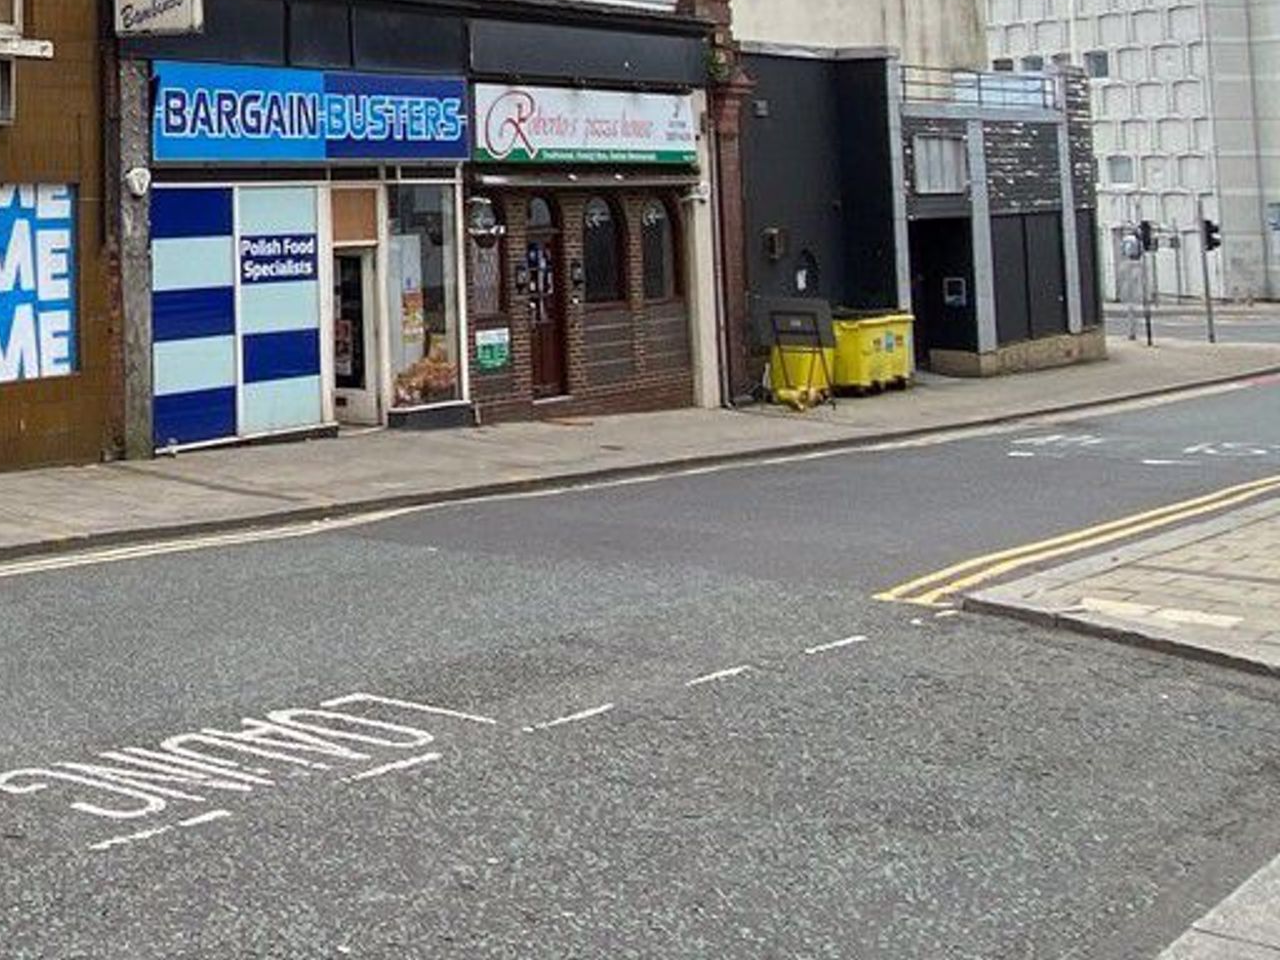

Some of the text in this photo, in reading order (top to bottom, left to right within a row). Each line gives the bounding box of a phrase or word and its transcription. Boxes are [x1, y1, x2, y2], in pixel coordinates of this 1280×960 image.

[163, 88, 461, 141] BARGAIN BUSTERS
[240, 237, 314, 256] Polish Food
[243, 260, 312, 281] Specialists
